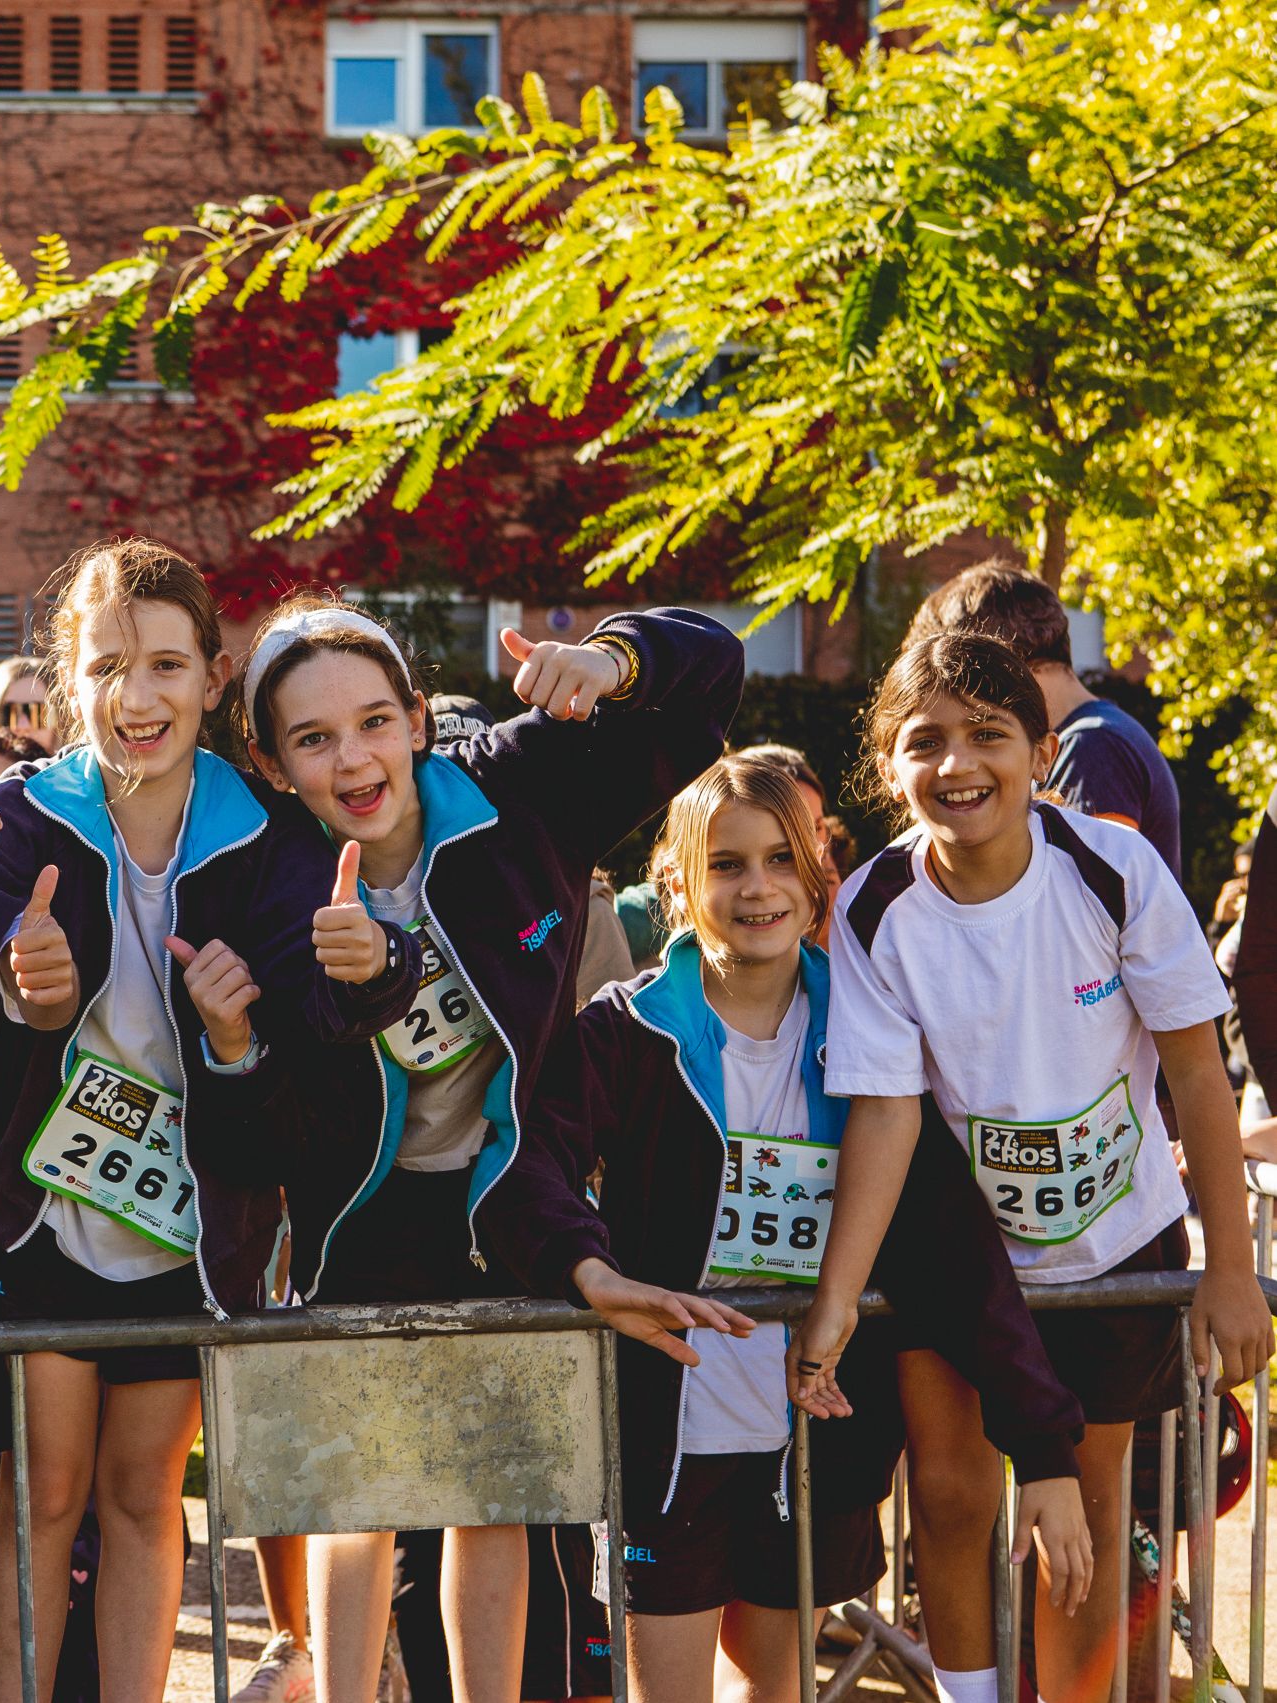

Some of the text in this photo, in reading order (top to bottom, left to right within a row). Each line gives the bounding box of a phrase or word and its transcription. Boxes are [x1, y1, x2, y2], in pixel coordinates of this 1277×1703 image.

[521, 909, 563, 952] ISABEL
[427, 968, 445, 982] Cugat
[1074, 979, 1102, 994] SANTA
[85, 1068, 122, 1098] 27è
[73, 1104, 93, 1118] Ciutat
[102, 1116, 117, 1129] Sant
[117, 1125, 136, 1138] Cugat
[78, 1086, 146, 1130] CROS
[985, 1143, 1057, 1166] CROS
[986, 1161, 1007, 1170] Ciutat
[60, 1133, 194, 1216] 2661
[996, 1158, 1120, 1216] 2669
[135, 1211, 162, 1229] SantCugat
[625, 1545, 657, 1563] BEL
